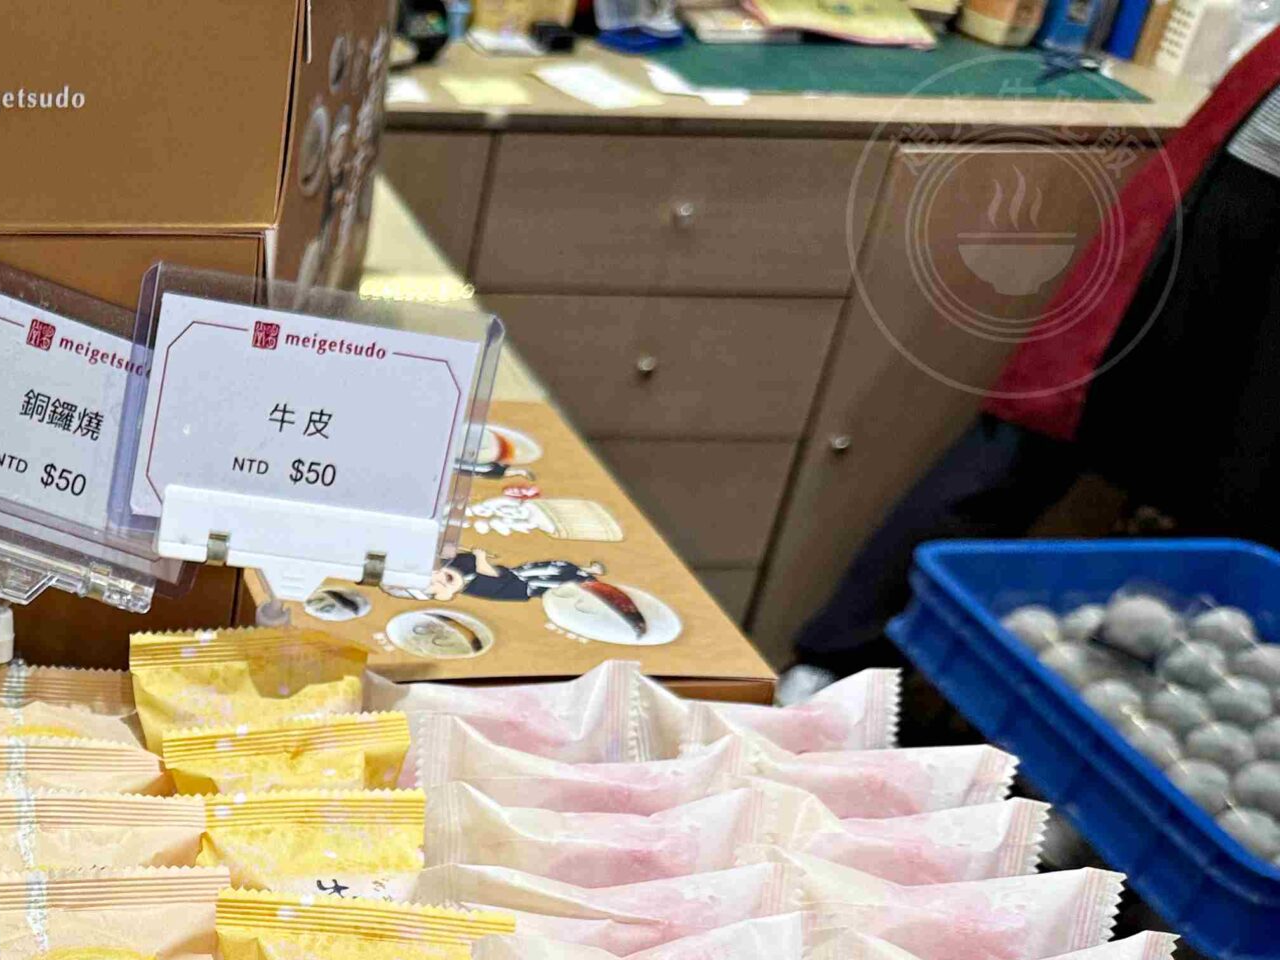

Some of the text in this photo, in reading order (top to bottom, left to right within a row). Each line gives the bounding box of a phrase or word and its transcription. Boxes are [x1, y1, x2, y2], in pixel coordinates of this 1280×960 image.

[285, 331, 387, 360] meigetsudo
[19, 388, 105, 441] 銅鑼燒
[268, 403, 333, 439] 牛皮
[40, 462, 87, 497] $50
[231, 456, 337, 487] NTD $50
